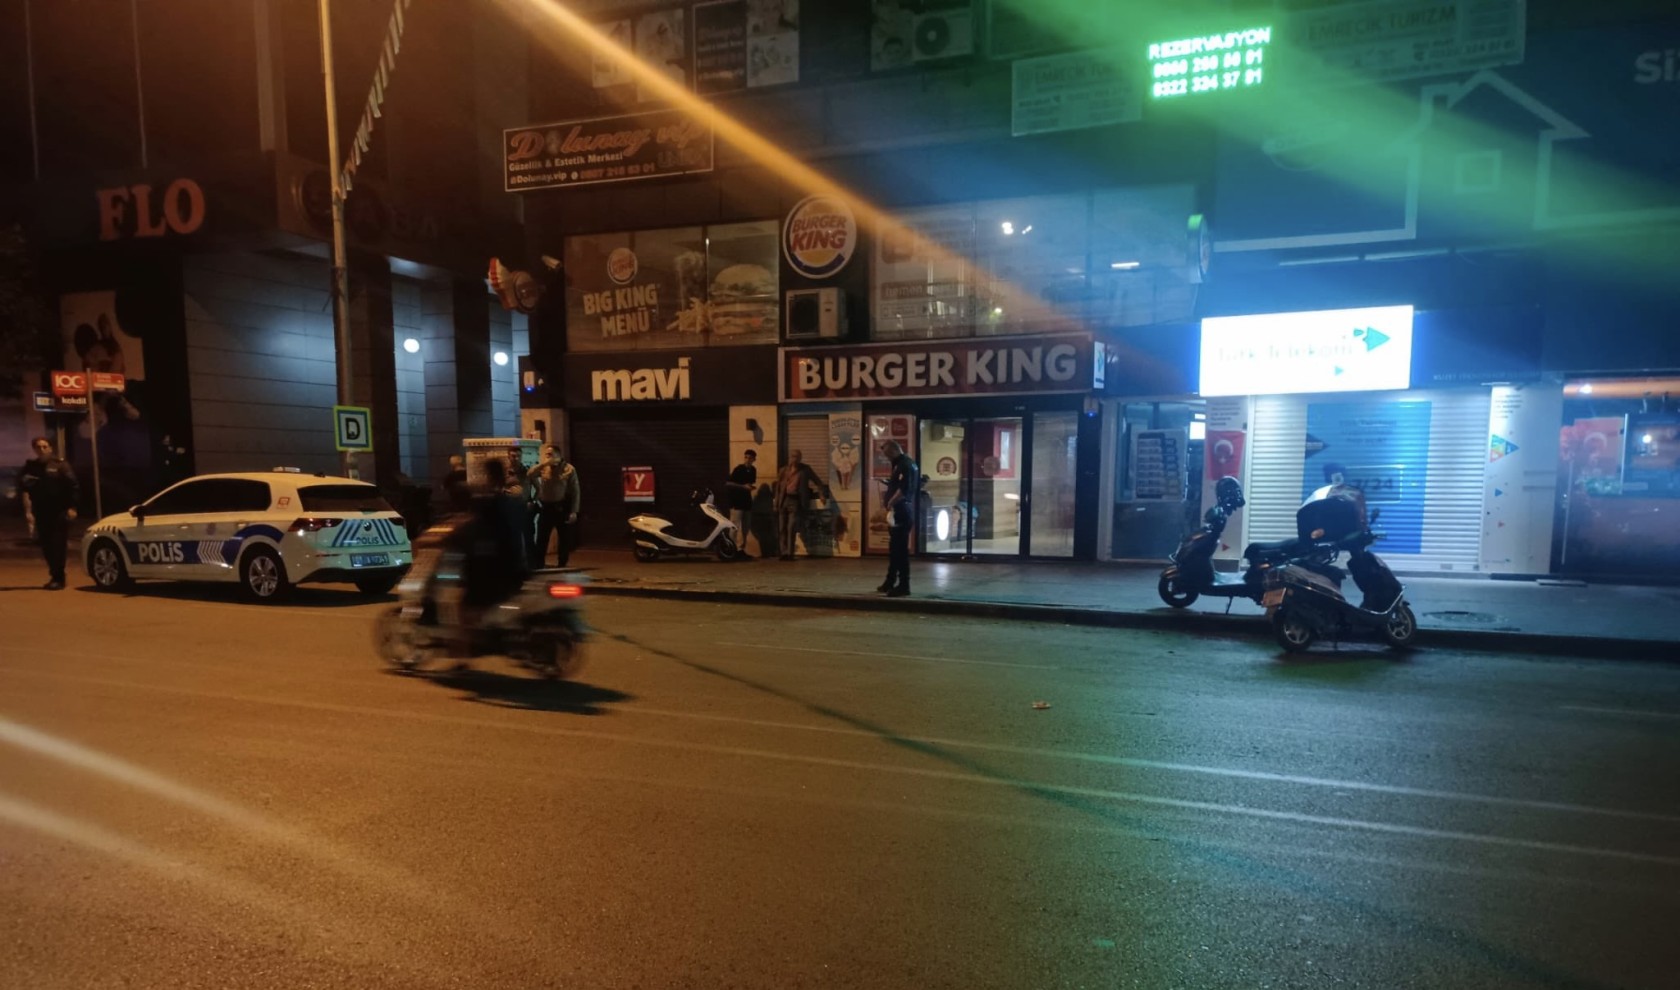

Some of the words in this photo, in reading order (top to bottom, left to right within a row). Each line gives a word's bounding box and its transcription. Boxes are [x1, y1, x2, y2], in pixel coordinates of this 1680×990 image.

[1148, 26, 1271, 60] REZERVASYON
[554, 156, 586, 167] Estetik
[95, 177, 205, 241] FLO
[791, 214, 847, 233] BURGER
[790, 230, 848, 252] KING
[582, 290, 613, 315] BIG
[615, 283, 658, 310] KING
[600, 307, 649, 338] MENÜ
[591, 356, 693, 402] mavi
[799, 352, 955, 391] BURGER
[966, 344, 1077, 386] KING
[345, 417, 360, 440] D
